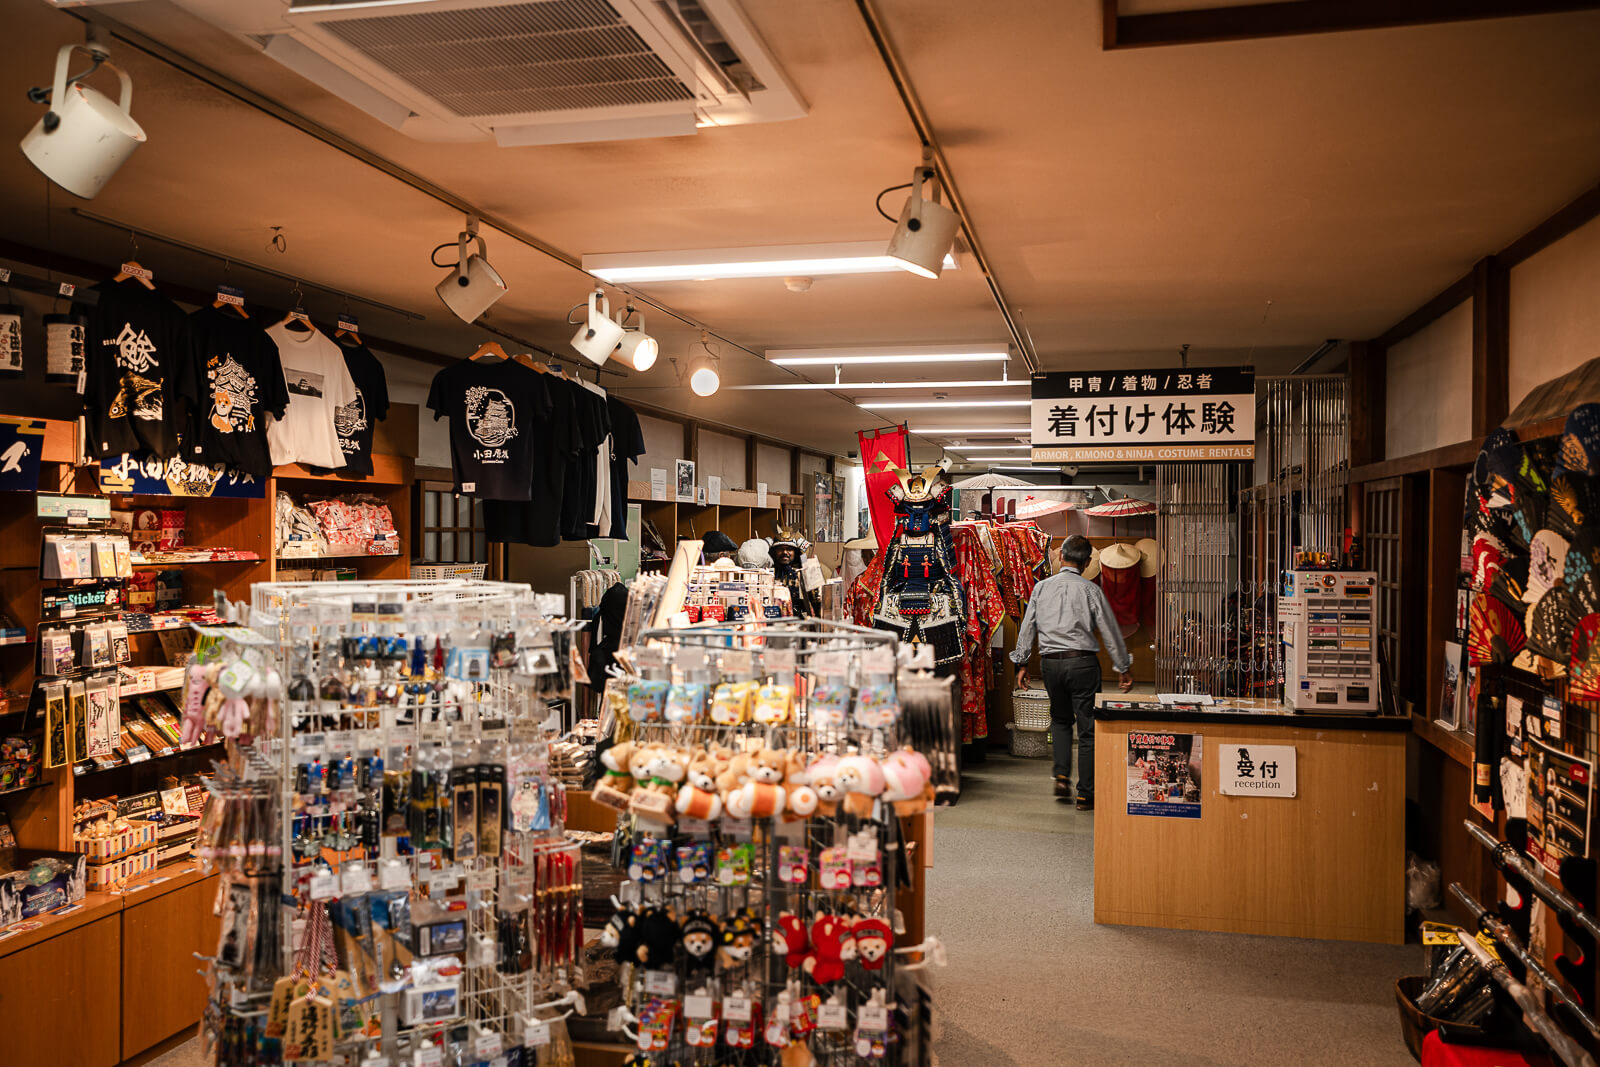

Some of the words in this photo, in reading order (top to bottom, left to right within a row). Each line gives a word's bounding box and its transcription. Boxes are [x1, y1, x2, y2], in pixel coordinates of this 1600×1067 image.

[1048, 401, 1236, 437] 着付け体験
[1076, 450, 1115, 460] KIMONO
[1117, 451, 1124, 459] &
[1125, 450, 1154, 459] NINJA
[1158, 448, 1205, 458] COSTUME
[1209, 447, 1252, 457] RENTALS
[68, 591, 106, 605] Sticker
[1237, 760, 1278, 778] 受付
[1234, 780, 1281, 789] reception
